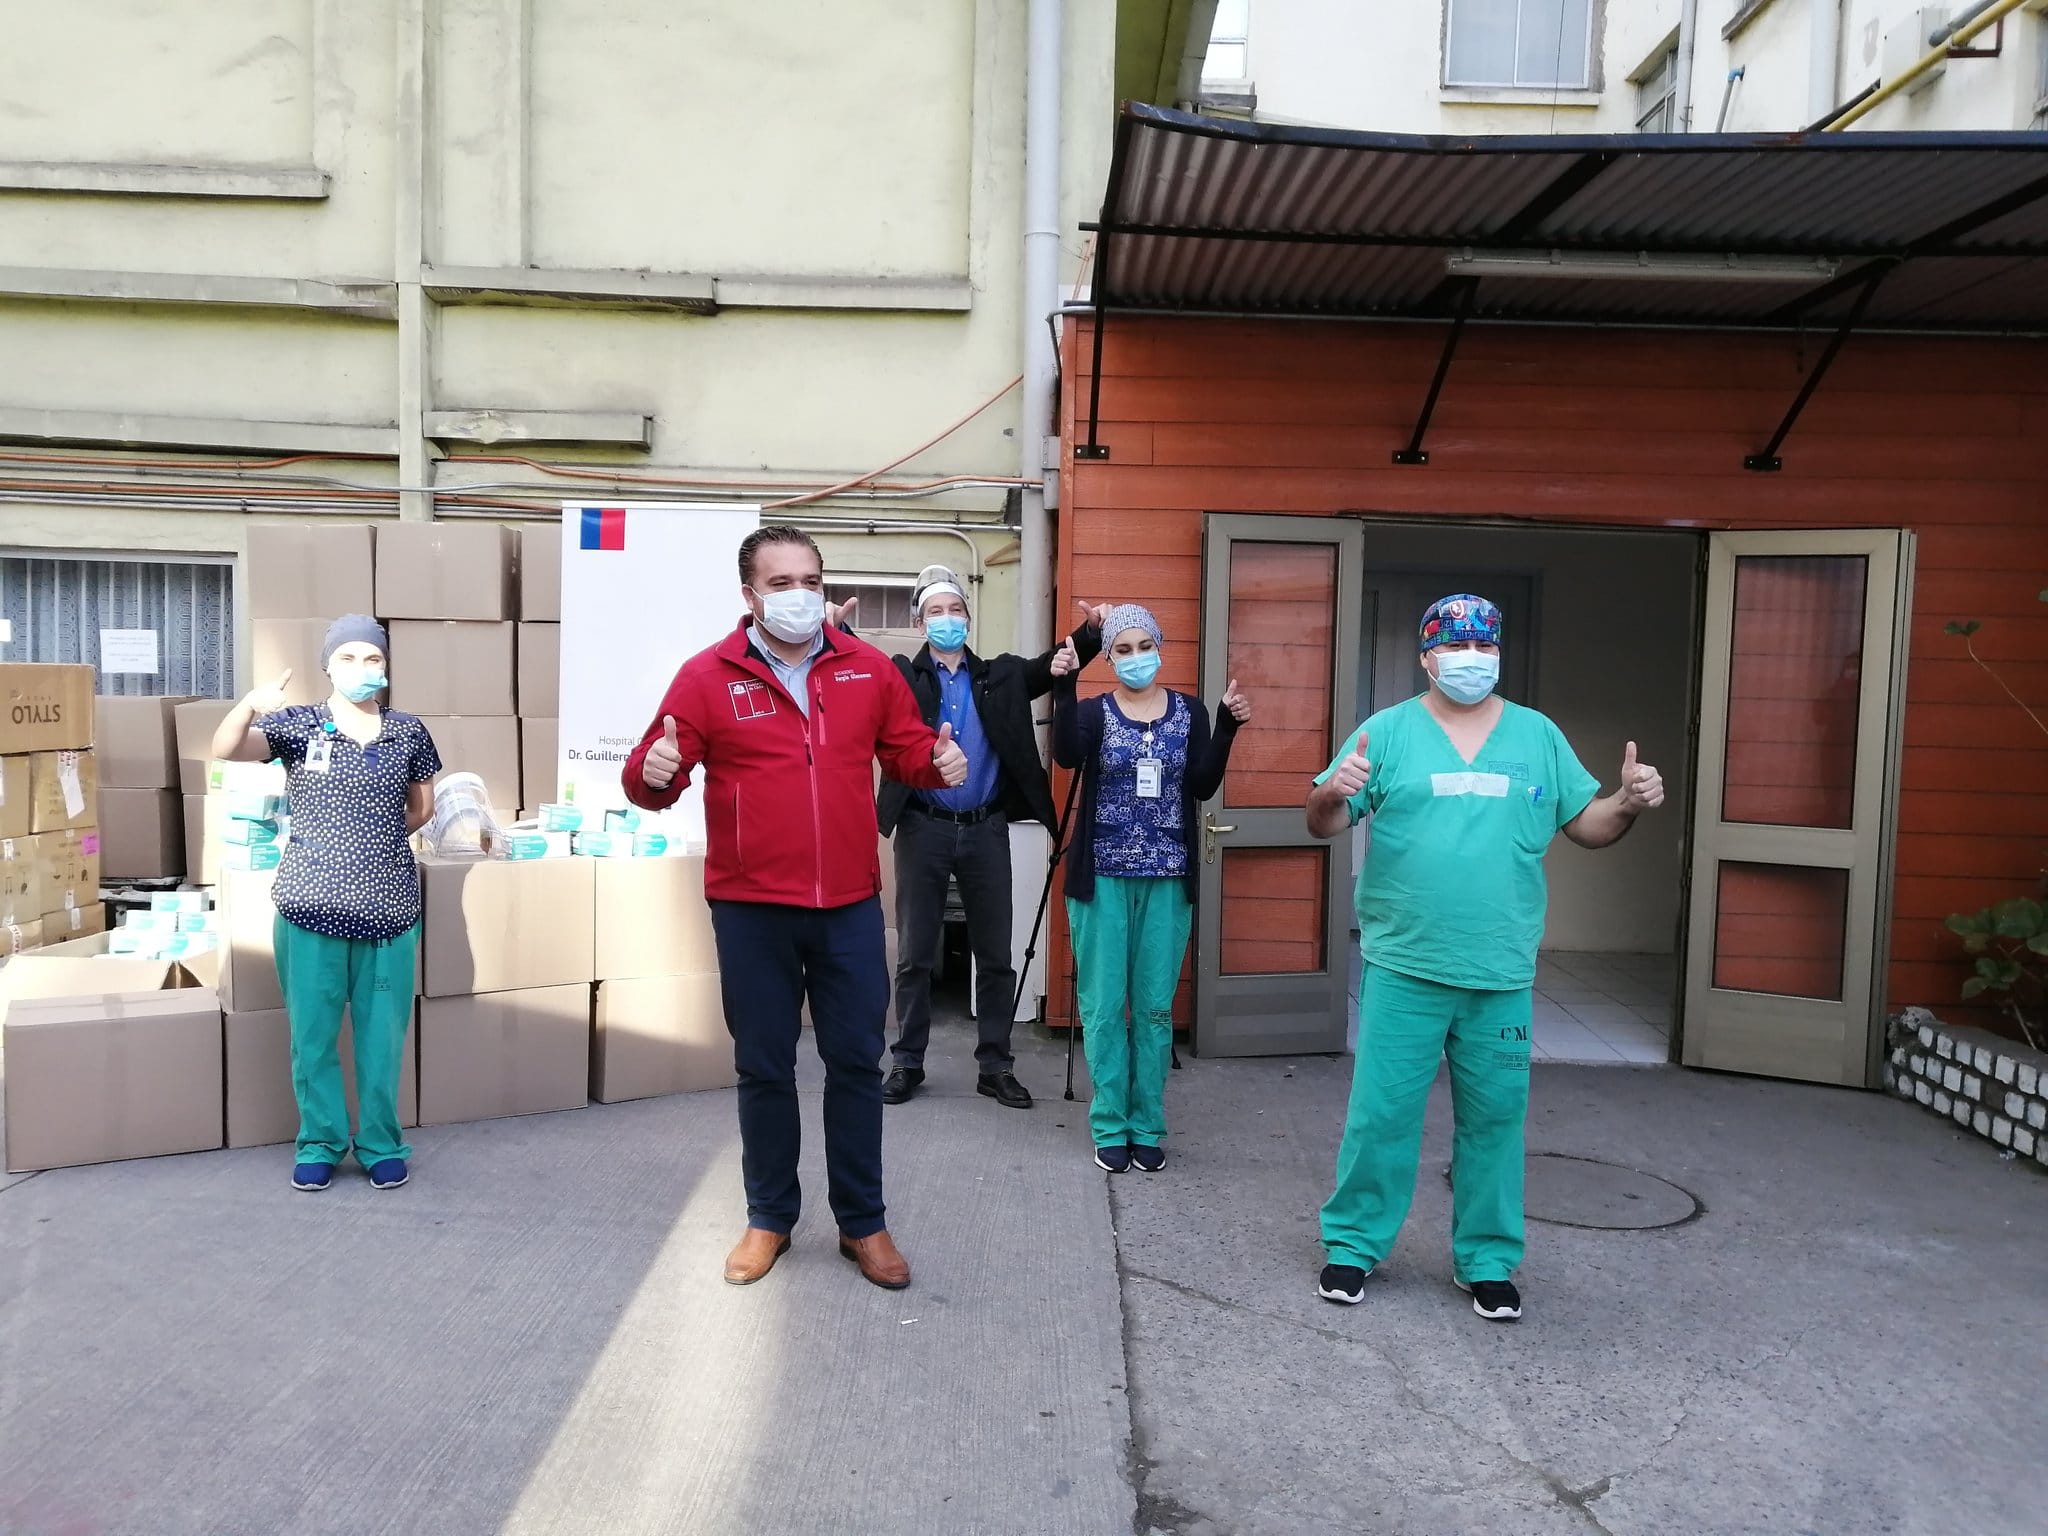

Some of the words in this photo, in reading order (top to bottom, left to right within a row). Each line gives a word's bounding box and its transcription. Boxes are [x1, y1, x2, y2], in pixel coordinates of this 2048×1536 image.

[12, 704, 61, 724] STYLO
[599, 735, 635, 747] Hospital
[568, 749, 582, 760] Dr.
